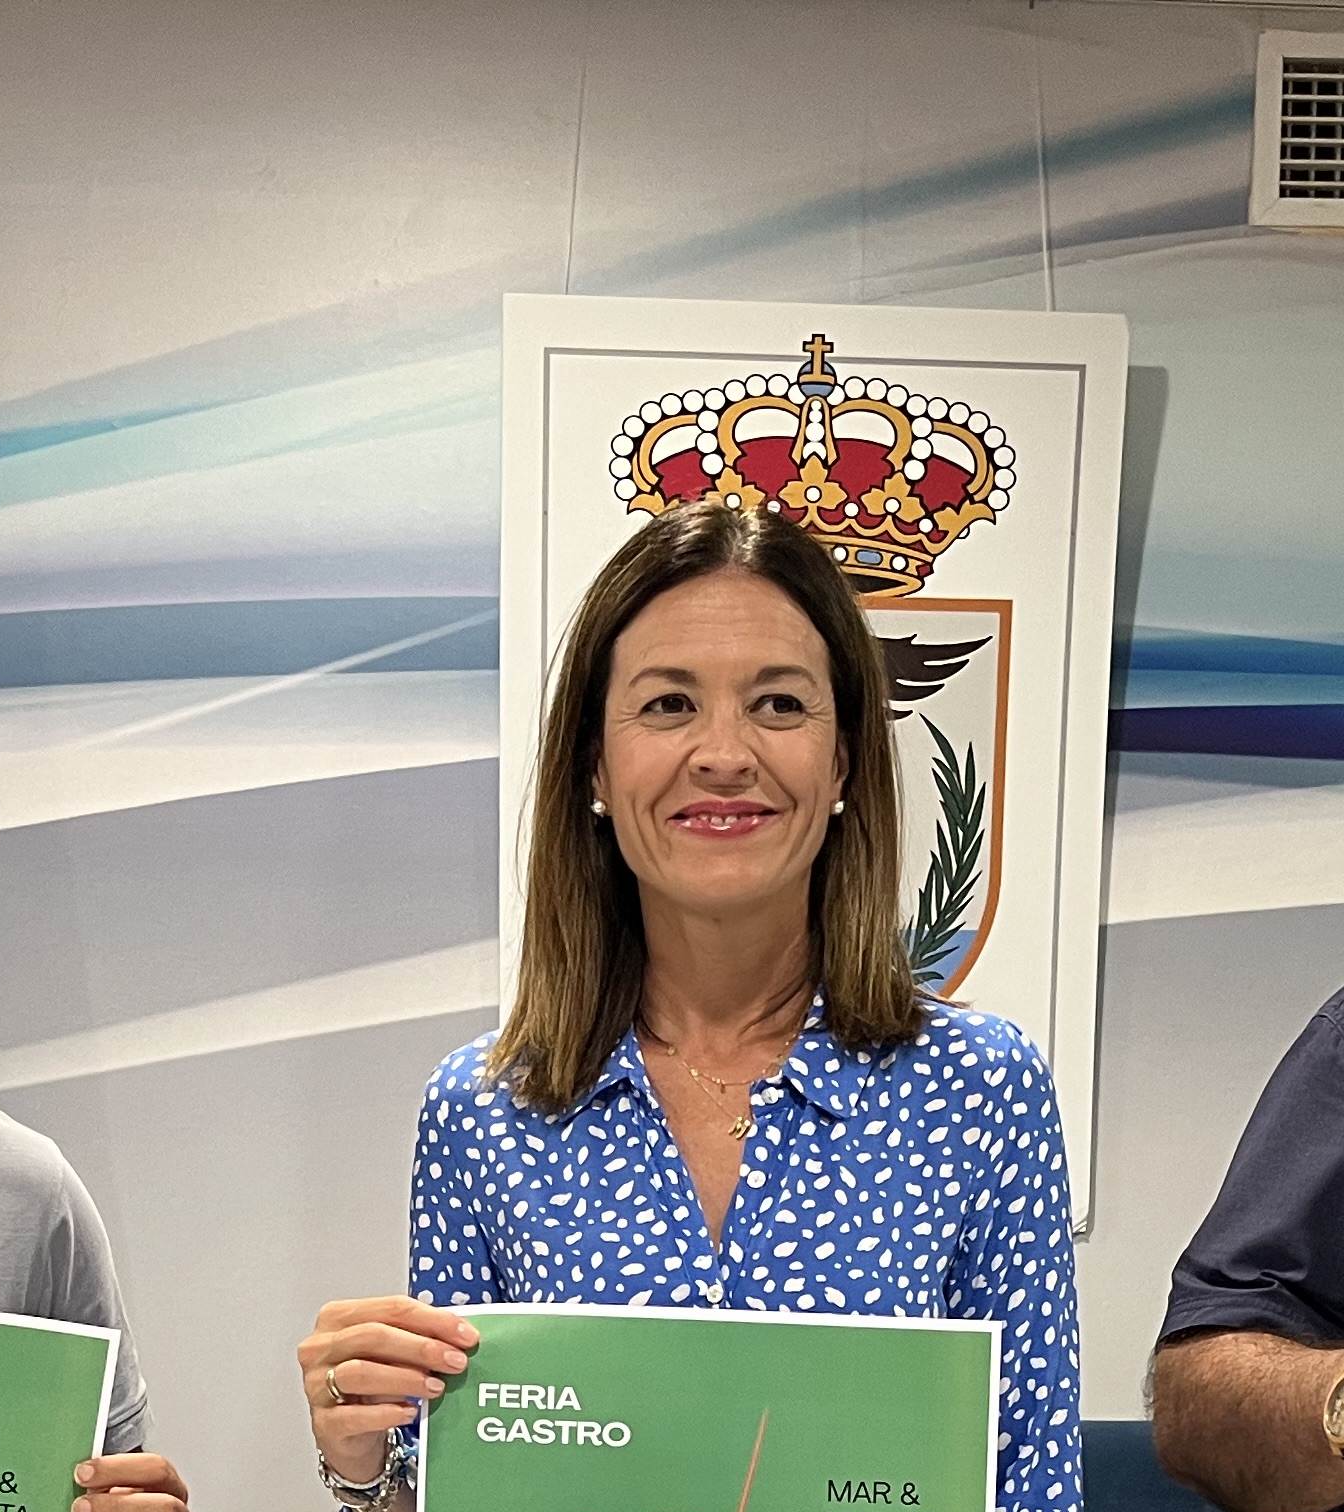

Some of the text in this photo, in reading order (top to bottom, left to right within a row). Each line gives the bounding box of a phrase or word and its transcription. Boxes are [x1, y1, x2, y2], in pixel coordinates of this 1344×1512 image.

[477, 1382, 582, 1412] FERIA
[476, 1416, 631, 1448] GASTRO
[826, 1479, 921, 1506] MAR &
